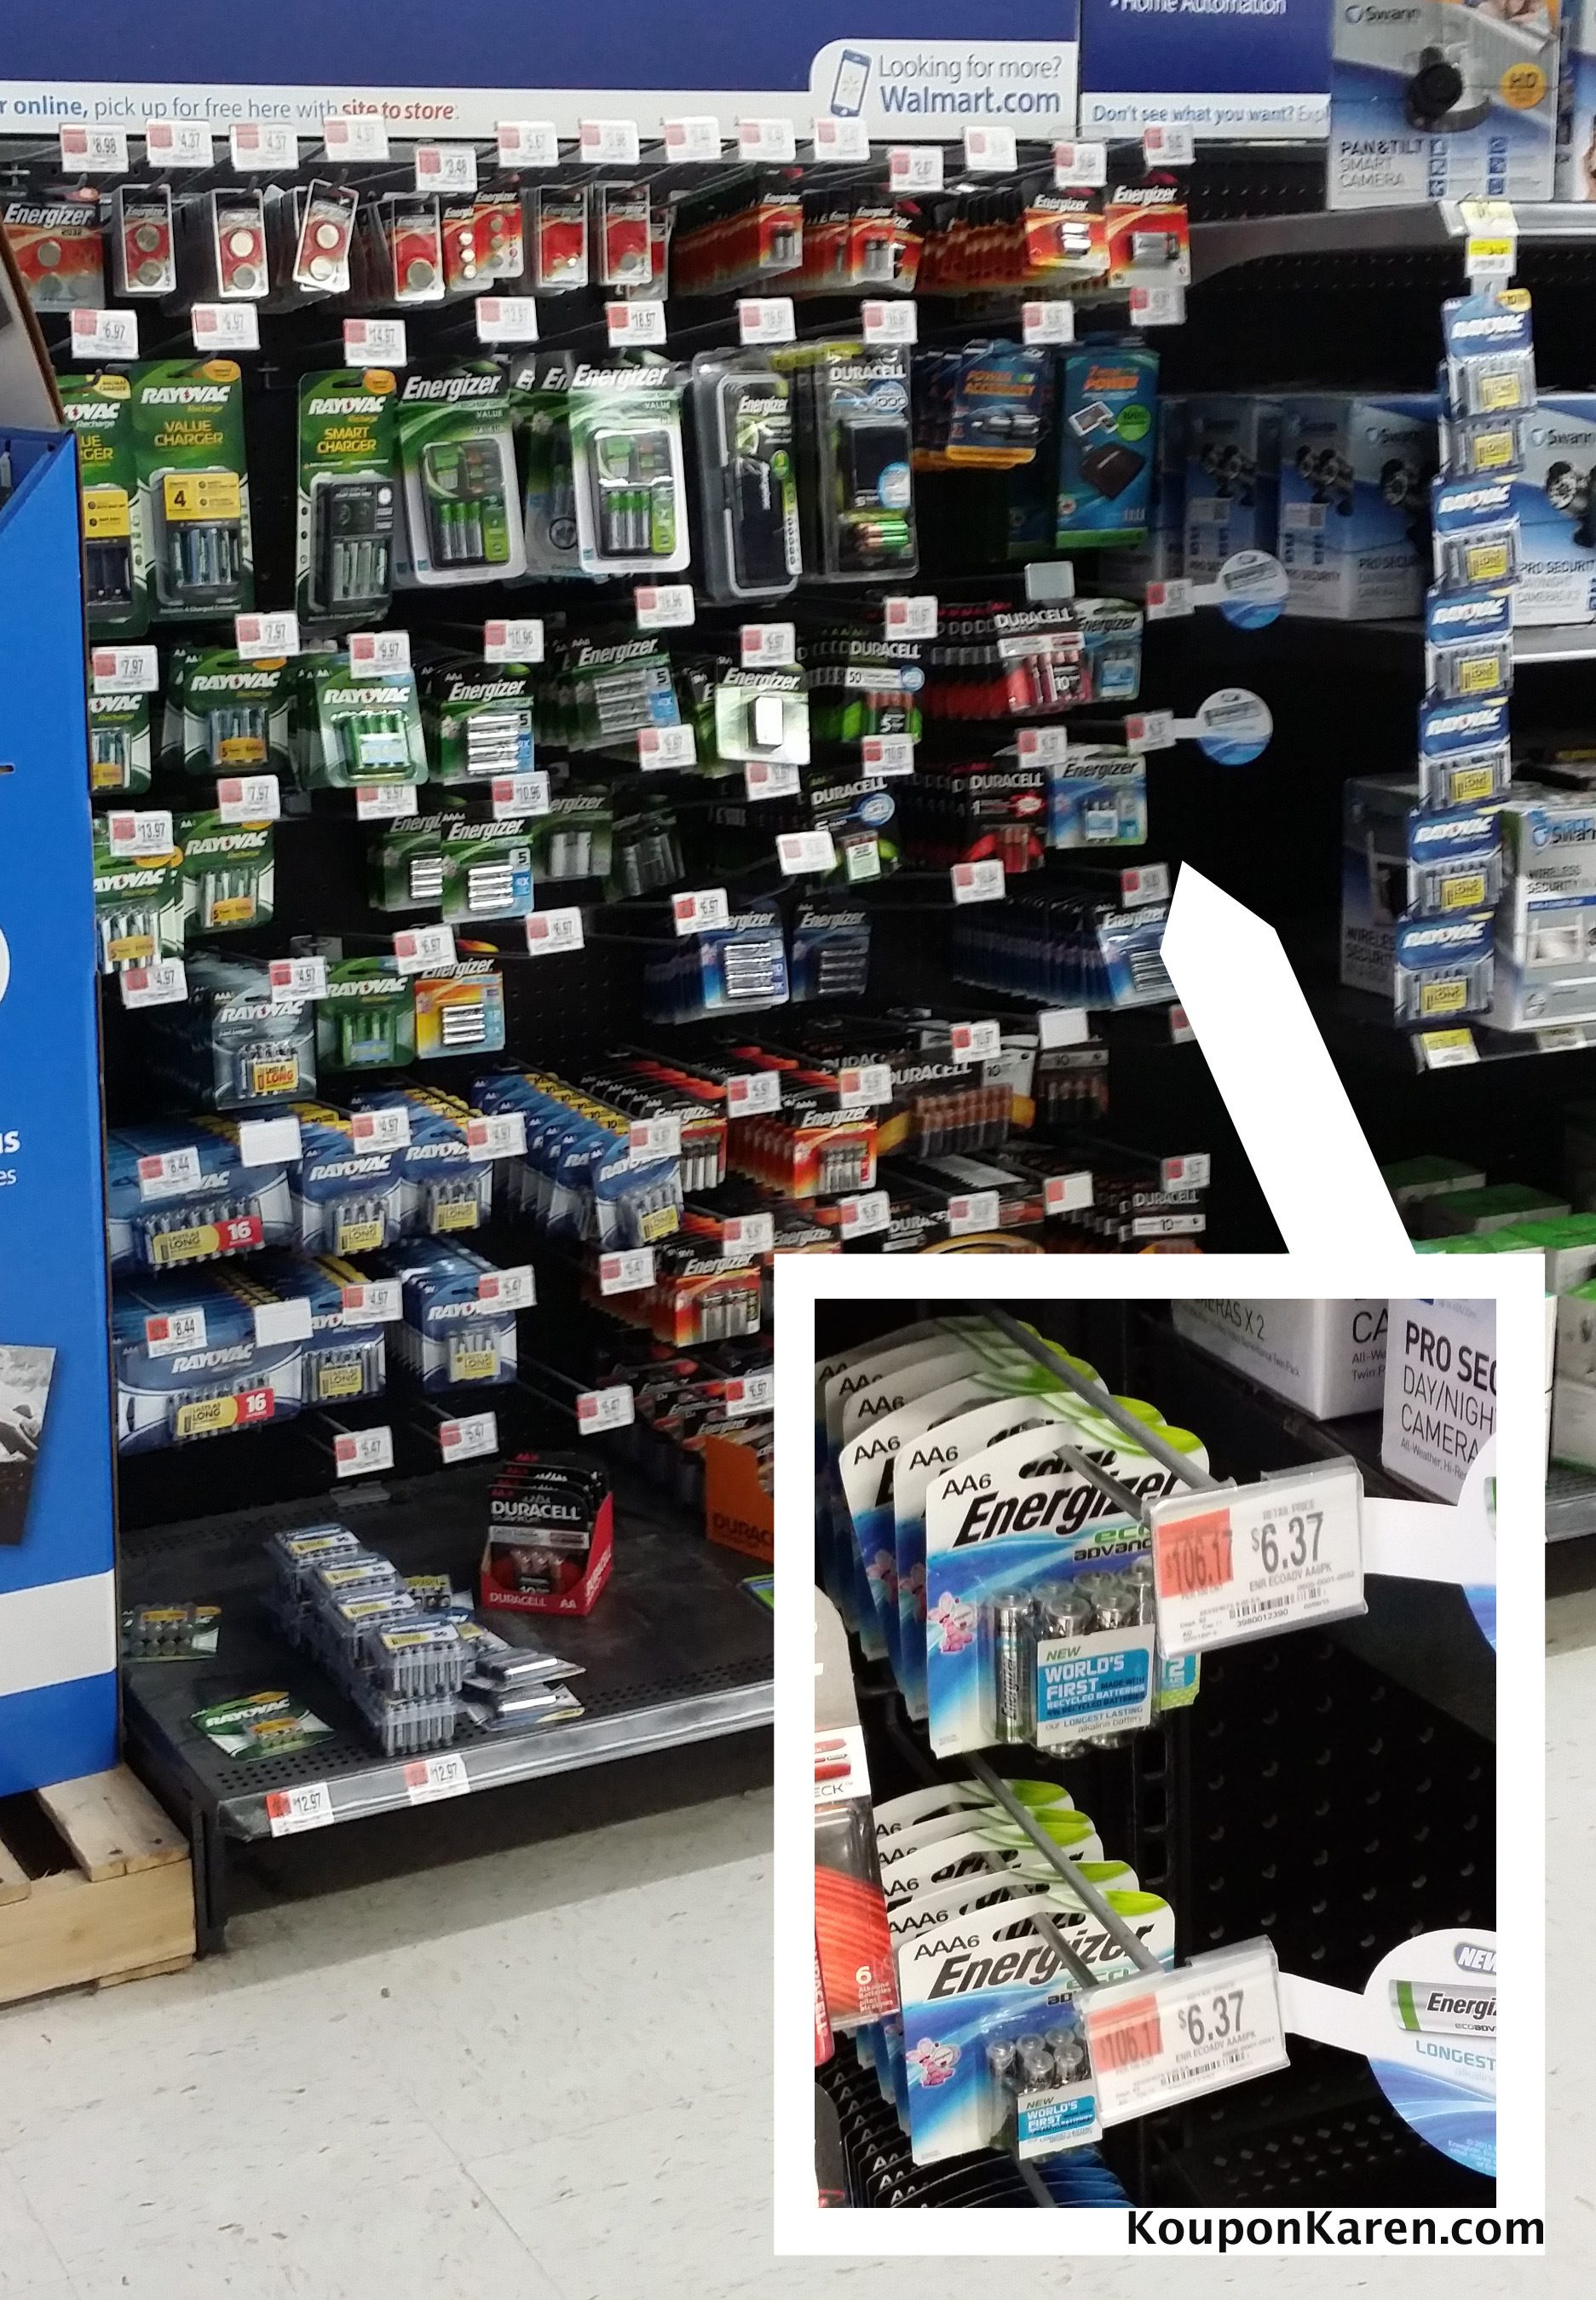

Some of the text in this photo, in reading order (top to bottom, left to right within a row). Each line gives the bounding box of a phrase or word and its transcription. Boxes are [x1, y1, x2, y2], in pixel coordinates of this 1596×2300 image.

[879, 54, 1062, 84] Looking for more?
[14, 95, 89, 118] online,
[95, 97, 135, 119] pick
[141, 101, 167, 119] up
[173, 97, 199, 118] for
[205, 99, 243, 118] free
[248, 99, 291, 118] here
[297, 99, 337, 118] with
[342, 99, 378, 117] site
[381, 103, 401, 119] to
[879, 85, 1060, 113] Walmart.com
[1093, 104, 1138, 122] Don't
[1142, 108, 1167, 122] see
[1173, 106, 1212, 122] what
[1213, 108, 1244, 126] you
[1249, 105, 1294, 122] want?
[1034, 194, 1090, 213] Energizer
[1111, 185, 1178, 205] Energizer
[4, 202, 93, 228] Energizer
[571, 364, 672, 393] Energizer
[829, 364, 907, 383] DURACELL
[140, 385, 232, 405] RAYOVAC
[401, 373, 503, 402] Energizer
[308, 395, 387, 416] RAYOVAC
[164, 420, 212, 433] VALUE
[324, 426, 371, 440] SMART
[154, 433, 224, 447] CHARGER
[316, 439, 377, 454] CHARGER
[173, 490, 187, 507] 4
[994, 606, 1074, 629] DURACELL
[577, 637, 659, 669] Energizer
[850, 640, 922, 660] DURACELL
[190, 672, 281, 692] RAYOVAC
[723, 666, 801, 692] Energizer
[323, 686, 411, 705] RAYOVAC
[447, 678, 527, 704] Energizer
[969, 771, 1045, 790] DURACELL
[1063, 758, 1139, 782] Energizer
[810, 775, 889, 806] DURACELL
[550, 793, 606, 815] ergizer
[389, 812, 443, 833] Energi
[447, 816, 524, 841] Energizer
[184, 830, 269, 856] RAYOVAC
[728, 910, 775, 932] ergizer
[799, 910, 867, 930] Energizer
[326, 976, 409, 998] RAYOVAC
[220, 1000, 305, 1023] RAYOVAC
[266, 1070, 294, 1084] LONG
[801, 1105, 869, 1128] Energizer
[308, 1153, 392, 1182] RAYOVAC
[227, 1219, 252, 1240] 16
[683, 1254, 754, 1277] Energizer
[1244, 1306, 1265, 1342] X 2
[1405, 1319, 1452, 1373] PRO
[171, 1342, 255, 1374] RAYOVAC
[245, 1392, 268, 1413] 16
[857, 1395, 905, 1418] AA6
[1403, 1364, 1497, 1436] DAY/NIGH
[1401, 1403, 1479, 1464] CAMERA
[853, 1435, 902, 1466] AA6
[908, 1445, 959, 1471] AA6
[941, 1473, 992, 1501] AA6
[490, 1500, 582, 1522] DURACELL
[1250, 1511, 1324, 1574] $6.37
[1249, 1577, 1267, 1593] ENR
[1268, 1569, 1304, 1588] ECOADV
[489, 1591, 548, 1607] DURACELL
[559, 1597, 578, 1610] AA
[1046, 1645, 1081, 1662] NEW
[1045, 1654, 1125, 1684] WORLD'S
[1046, 1676, 1099, 1701] FIRST
[1046, 1683, 1145, 1709] RECYCLED BATTERIES
[205, 1698, 291, 1727] RAYOVAC
[1063, 1712, 1105, 1727] LONGEST
[1105, 1706, 1144, 1720] LASTING
[888, 1909, 949, 1934] AAA6
[913, 1934, 980, 1962] AAA6
[855, 1965, 873, 1986] 6
[1178, 1989, 1244, 2046] $6.37
[1426, 1992, 1497, 2020] Energi
[1415, 2039, 1497, 2072] LONGEST
[1026, 2095, 1055, 2110] NEW
[1027, 2100, 1078, 2121] WORLD'S
[1028, 2113, 1063, 2130] FIRST
